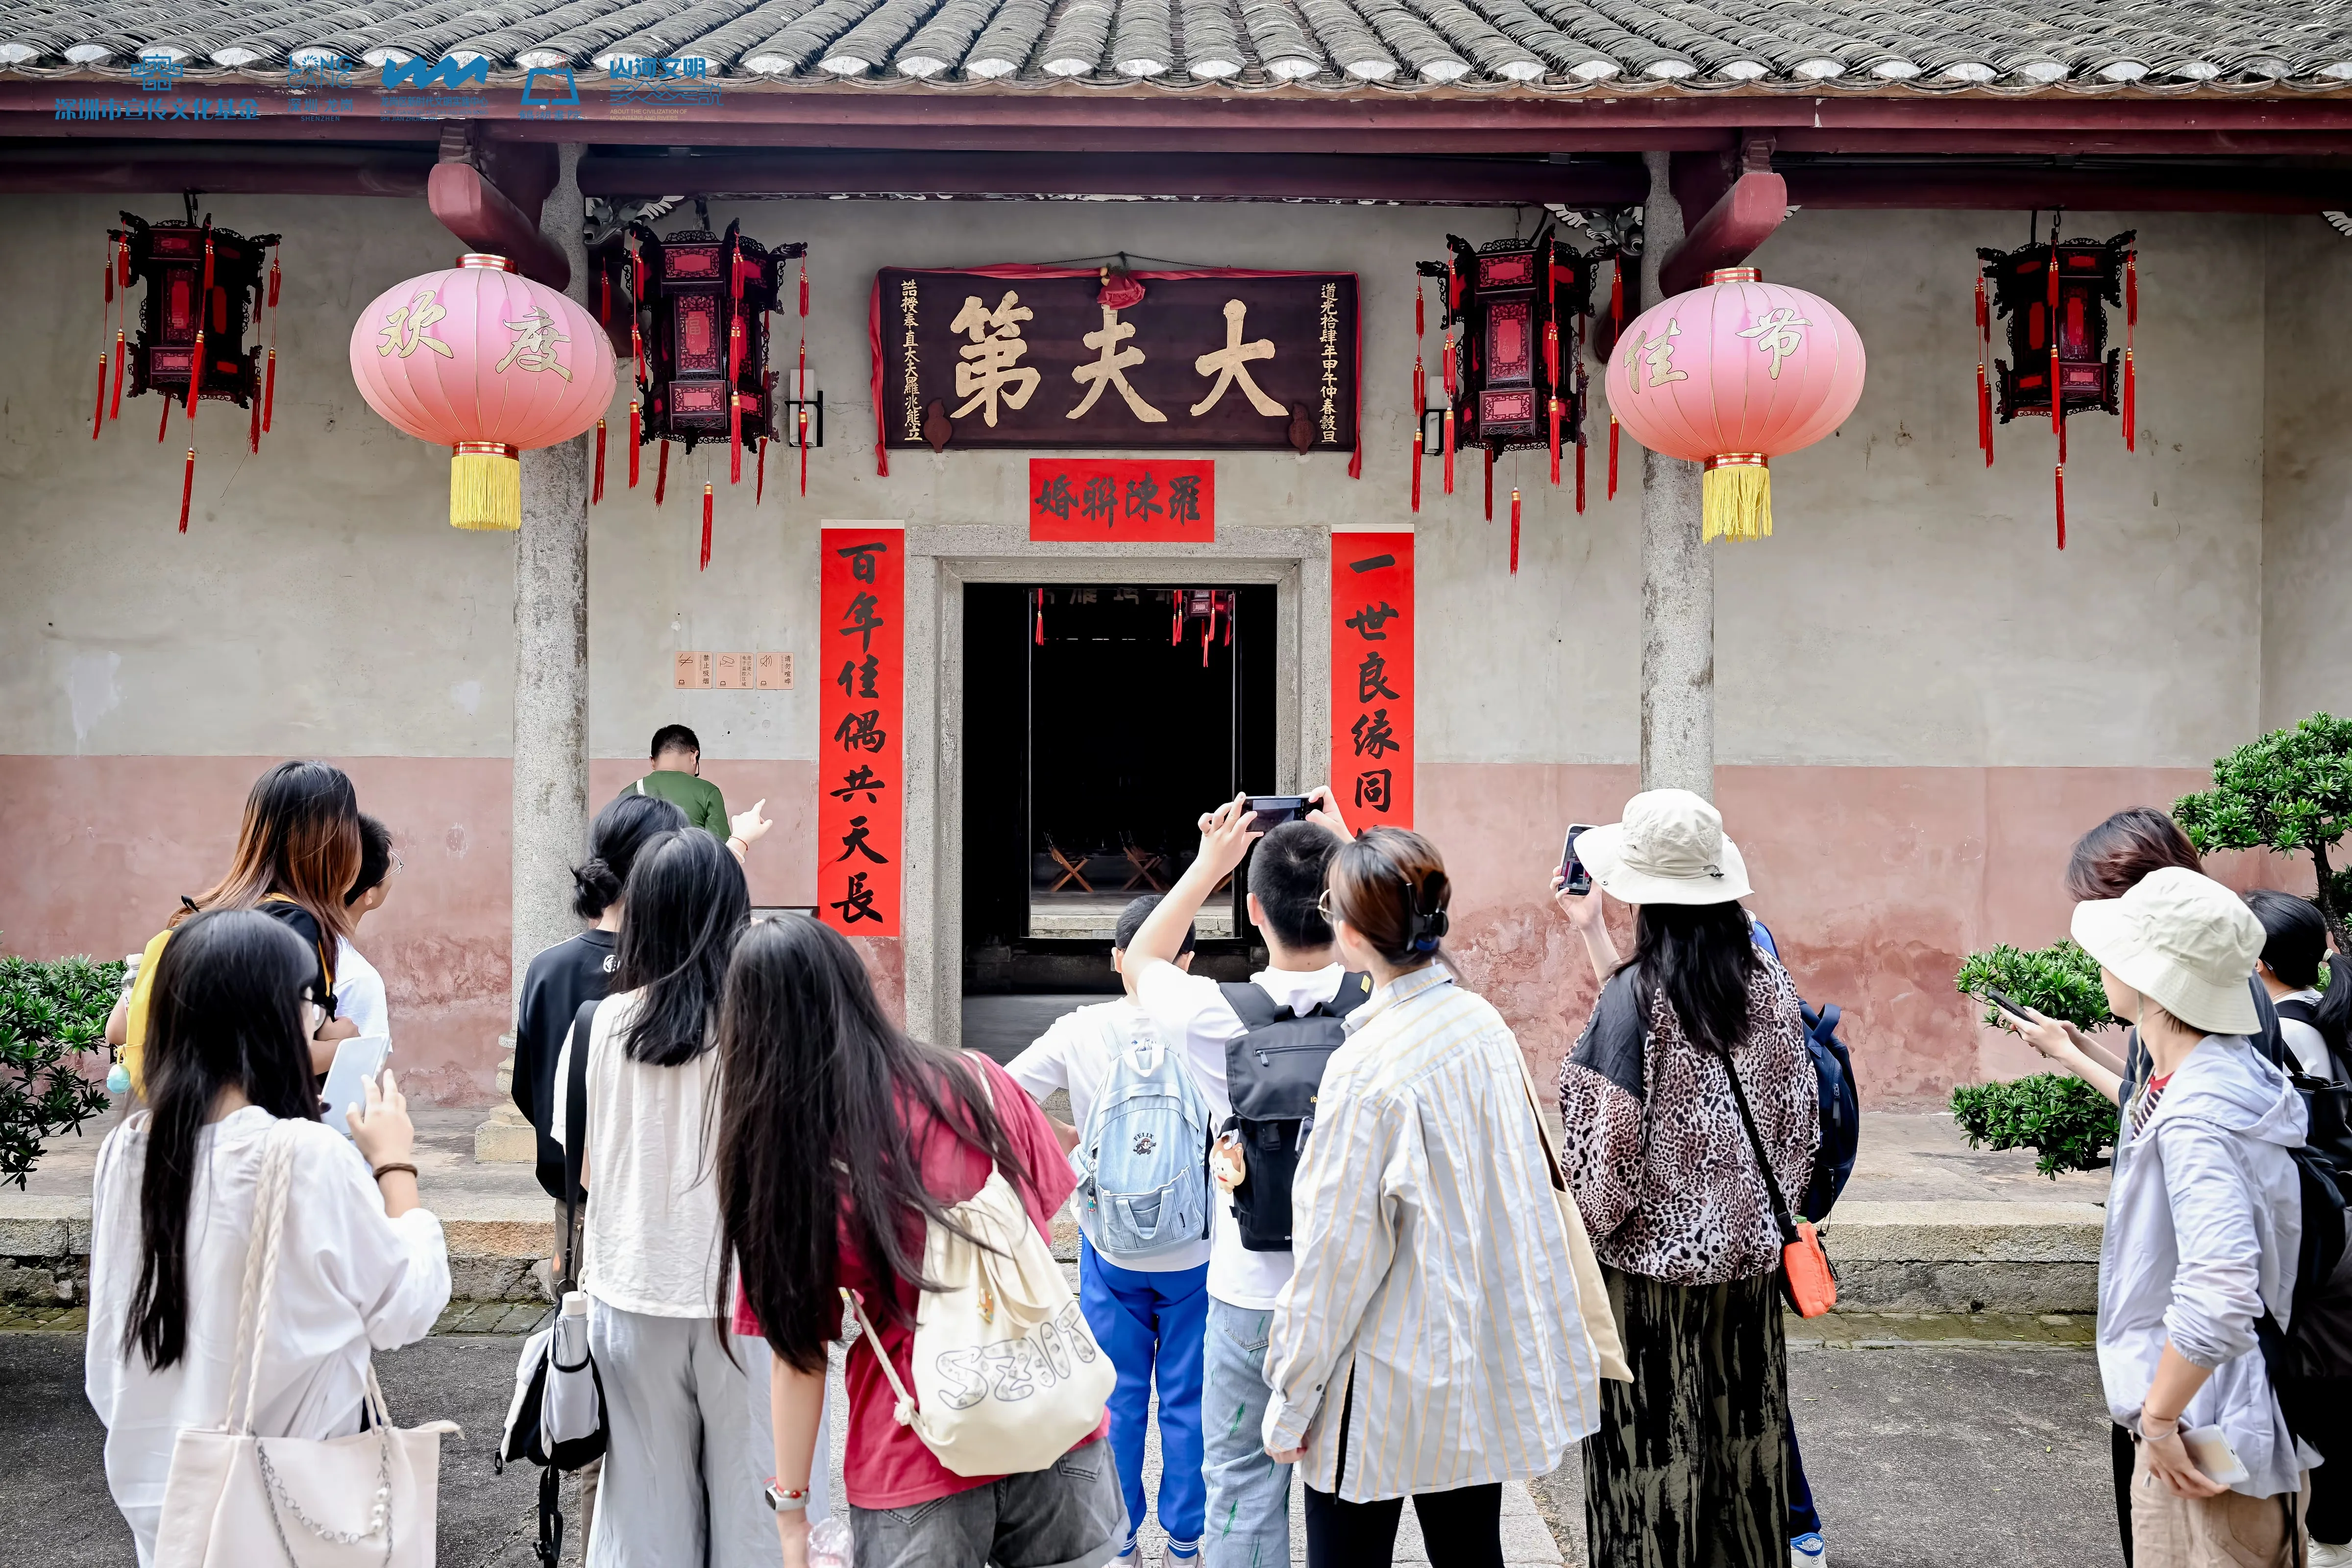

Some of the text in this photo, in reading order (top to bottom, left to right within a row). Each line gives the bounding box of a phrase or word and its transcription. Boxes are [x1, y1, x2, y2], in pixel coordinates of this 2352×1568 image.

[377, 290, 573, 383] 欢度
[1623, 308, 1813, 394] 佳节
[1133, 1132, 1154, 1141] FELIX
